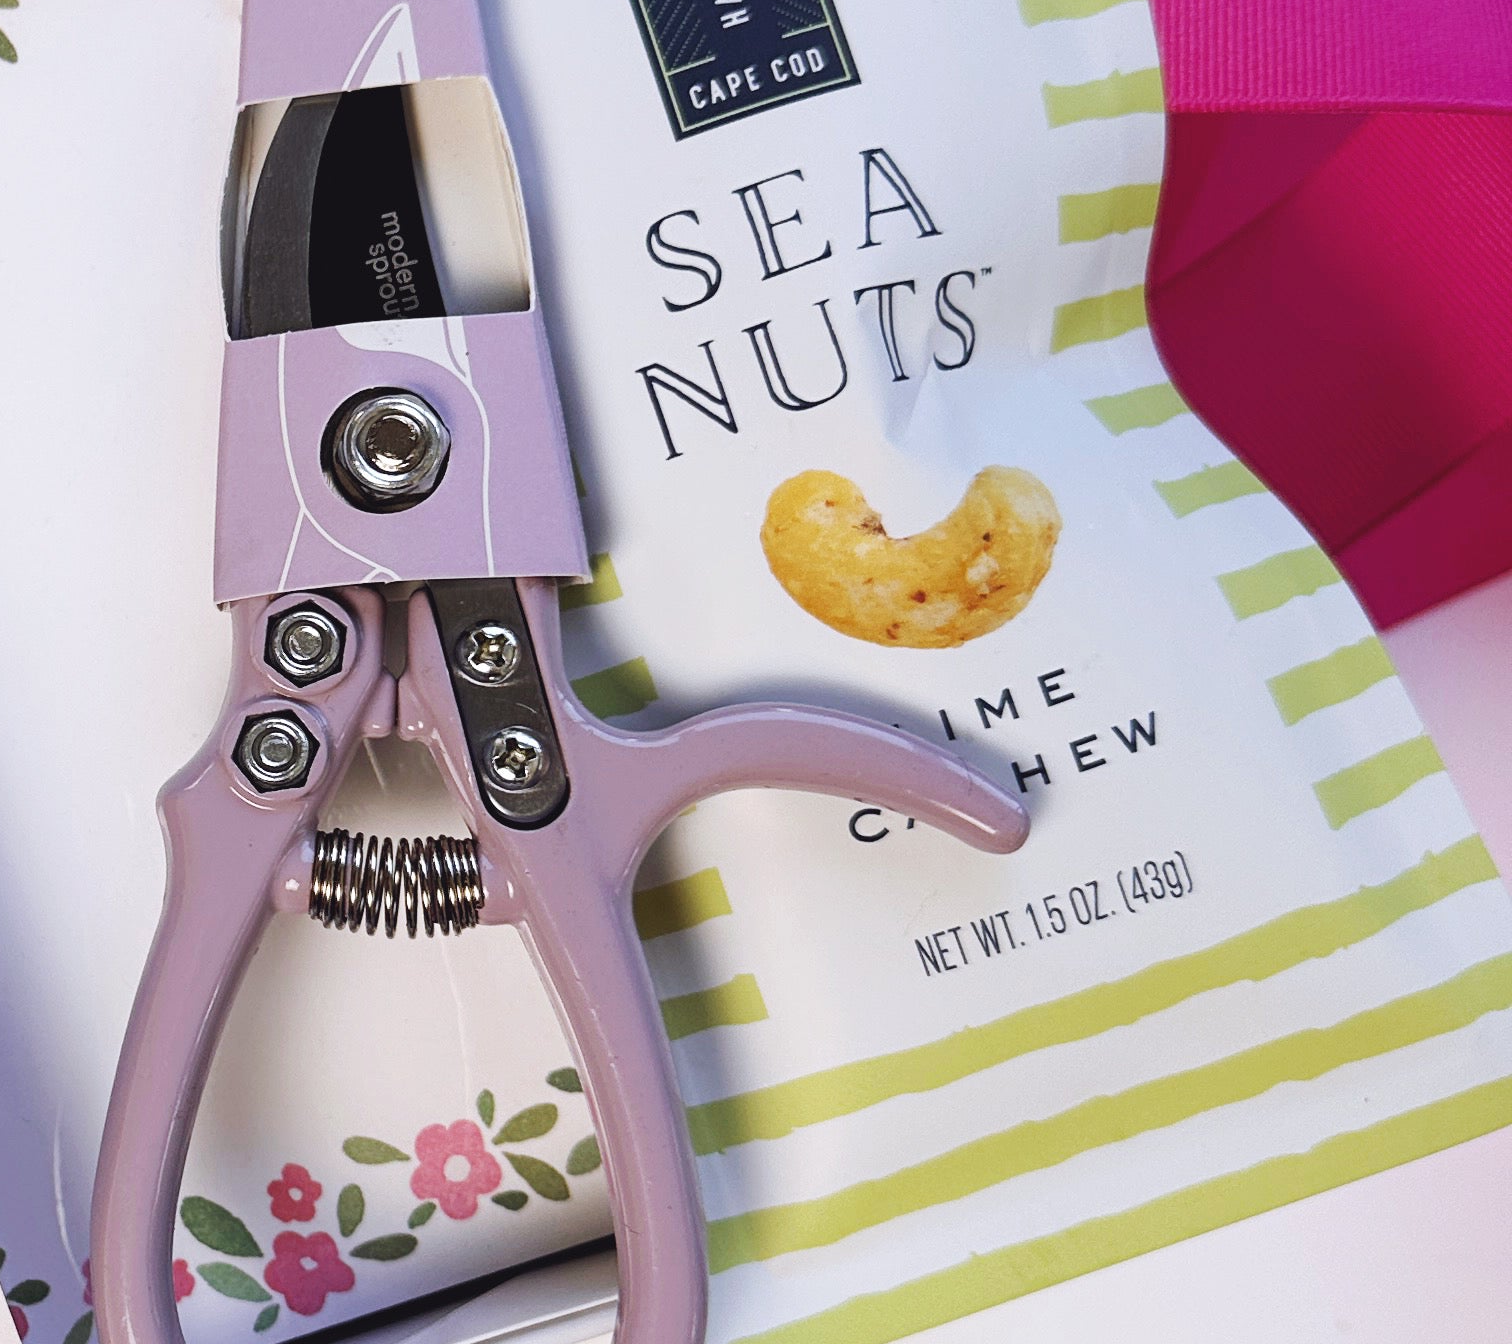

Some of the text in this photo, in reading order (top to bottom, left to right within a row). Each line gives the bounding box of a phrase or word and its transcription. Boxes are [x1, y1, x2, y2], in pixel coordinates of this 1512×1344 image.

[687, 46, 826, 109] CAPE COD
[365, 242, 408, 319] sprou
[381, 210, 420, 312] modern
[644, 148, 944, 313] SEA
[893, 667, 1076, 743] IME
[848, 711, 1158, 844] CHEW
[914, 850, 1194, 977] NET WT. 1.5 OZ. (43g)
